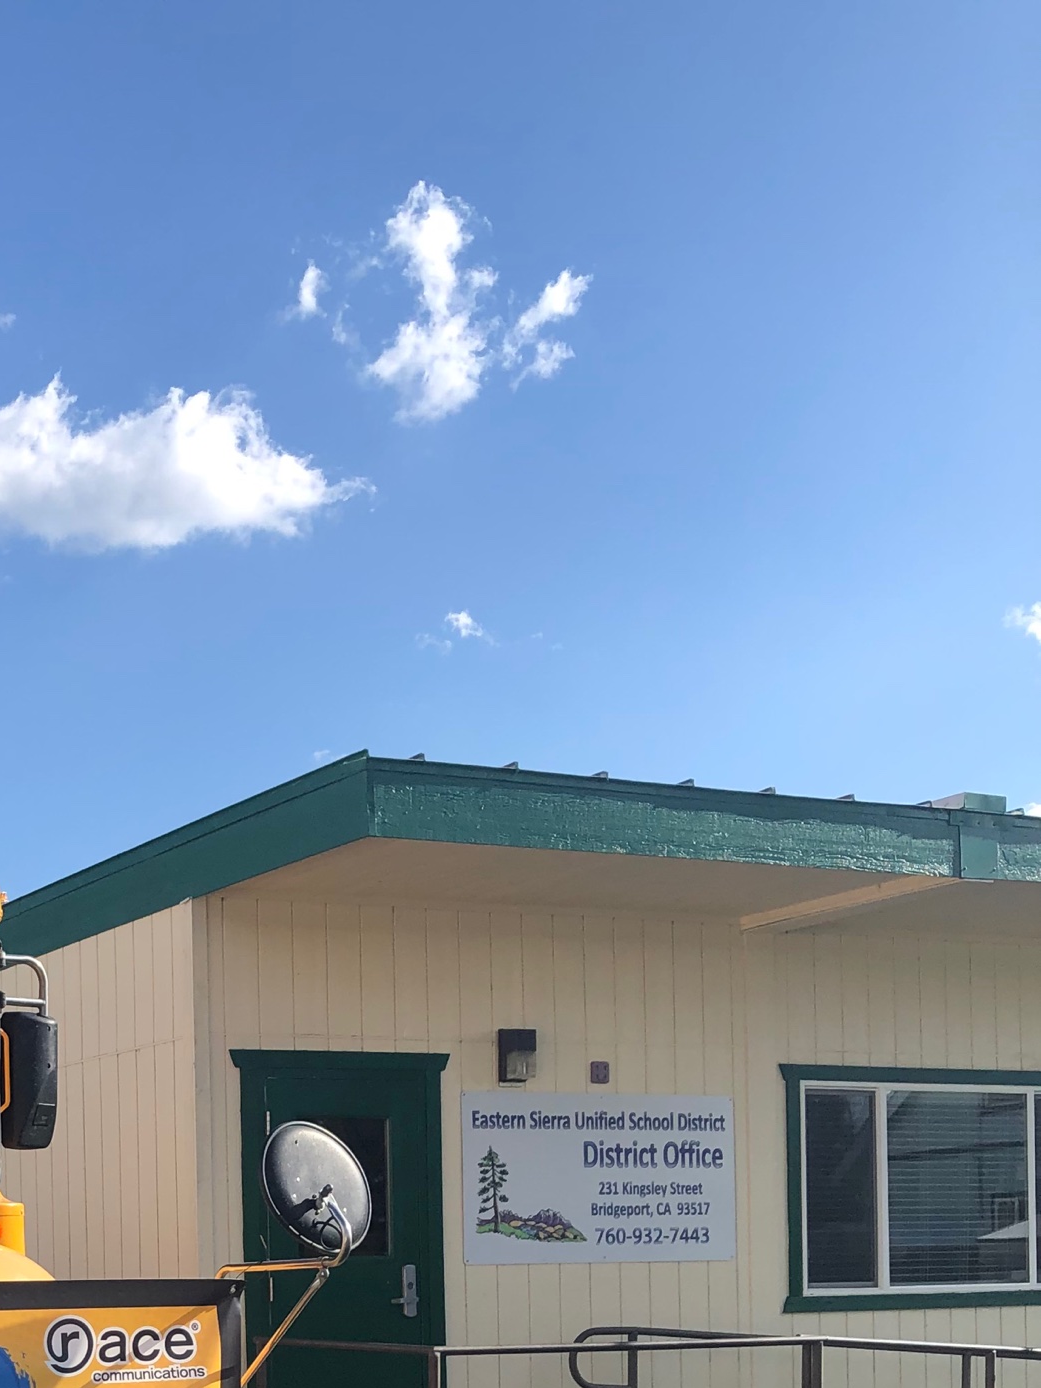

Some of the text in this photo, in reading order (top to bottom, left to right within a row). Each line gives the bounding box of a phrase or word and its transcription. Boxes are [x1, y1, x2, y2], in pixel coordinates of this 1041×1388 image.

[471, 1110, 726, 1132] Eastern Sierra Unified School District
[583, 1140, 724, 1169] District Office
[598, 1181, 703, 1198] 231 Kingsley Street
[591, 1202, 710, 1219] Bridgeport, CA 93517
[594, 1227, 710, 1245] 760-932-7443
[93, 1366, 205, 1383] communications
